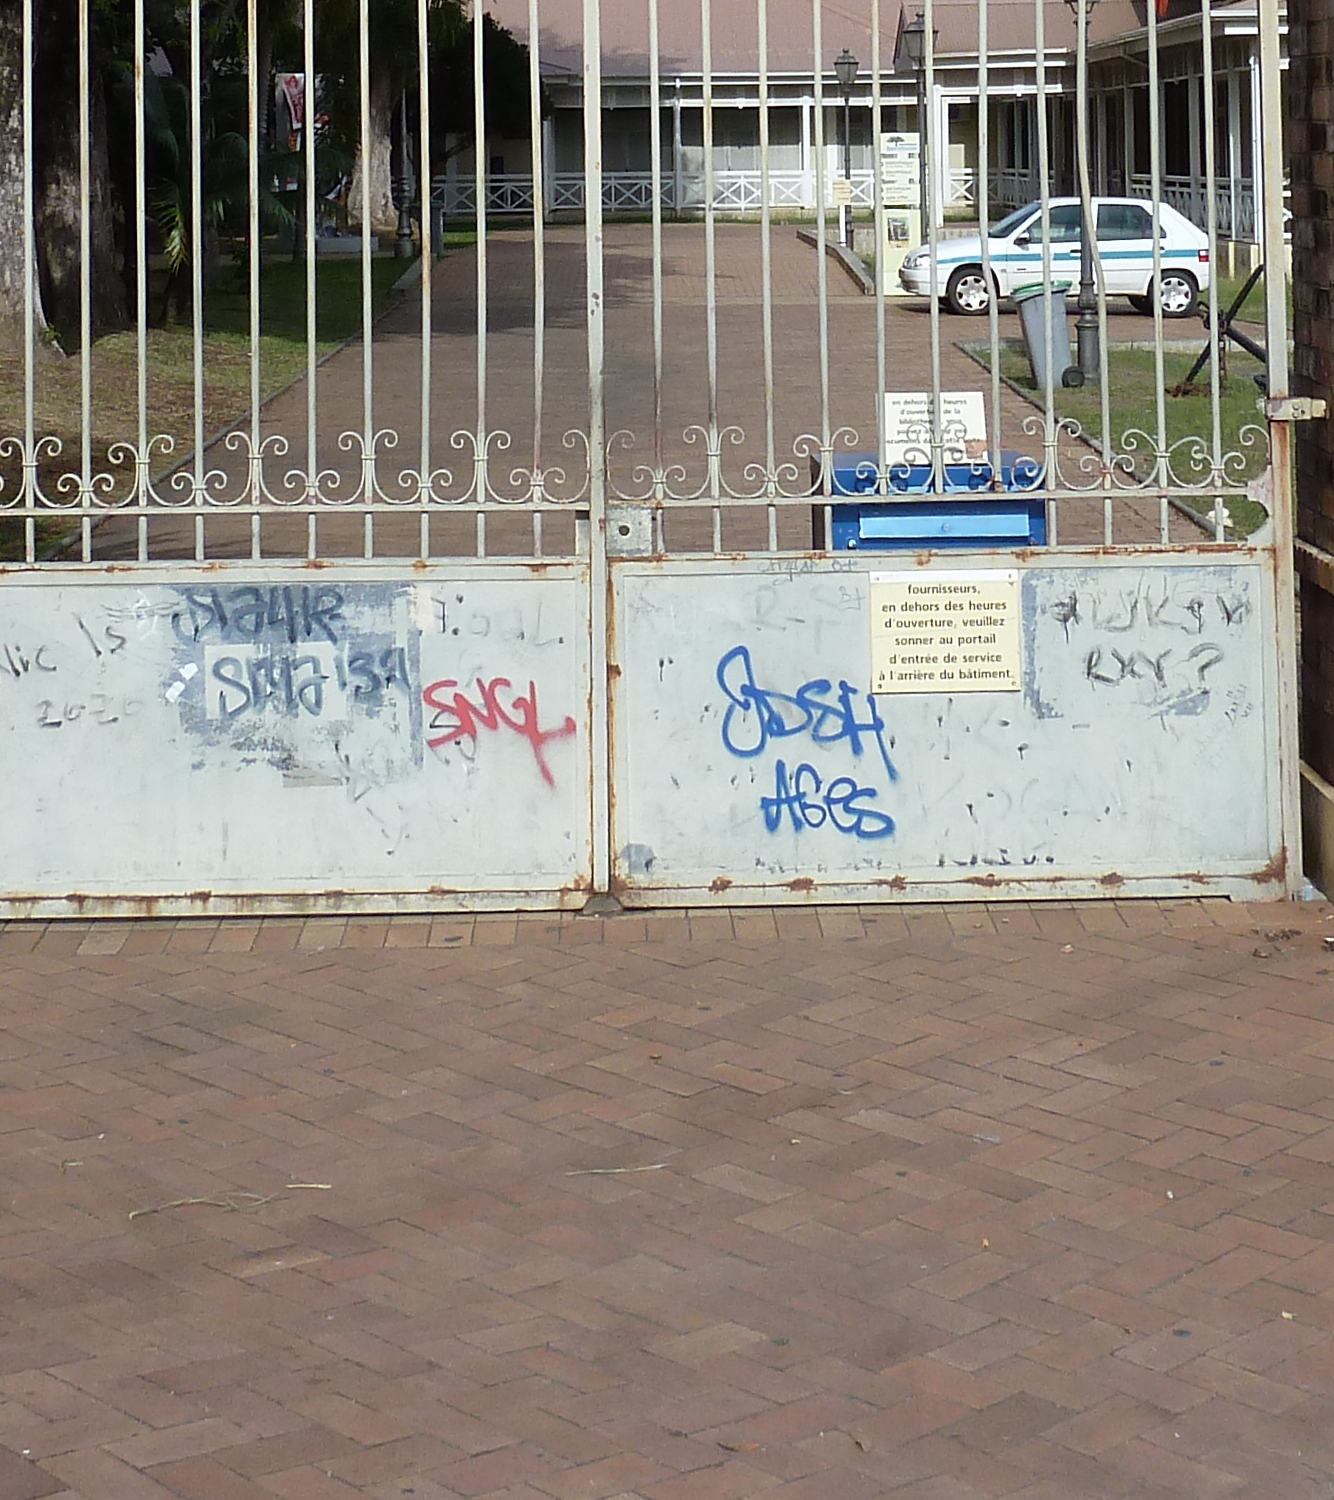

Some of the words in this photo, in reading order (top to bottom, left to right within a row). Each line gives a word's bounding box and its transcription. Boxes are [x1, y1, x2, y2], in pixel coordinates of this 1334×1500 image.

[907, 584, 981, 595] fournisseurs,
[882, 603, 896, 612] en
[900, 601, 940, 612] dehors
[944, 601, 964, 611] des
[968, 600, 1007, 611] heures
[884, 617, 957, 629] d'ouverture,
[962, 616, 1006, 627] veuillez
[894, 636, 934, 646] sonner
[939, 635, 953, 644] au
[958, 633, 996, 647] portail
[889, 653, 939, 665] d'entrée
[943, 653, 958, 664] de
[962, 652, 1002, 663] service
[879, 670, 885, 681] à
[889, 670, 935, 681] l'arrière
[939, 669, 955, 680] du
